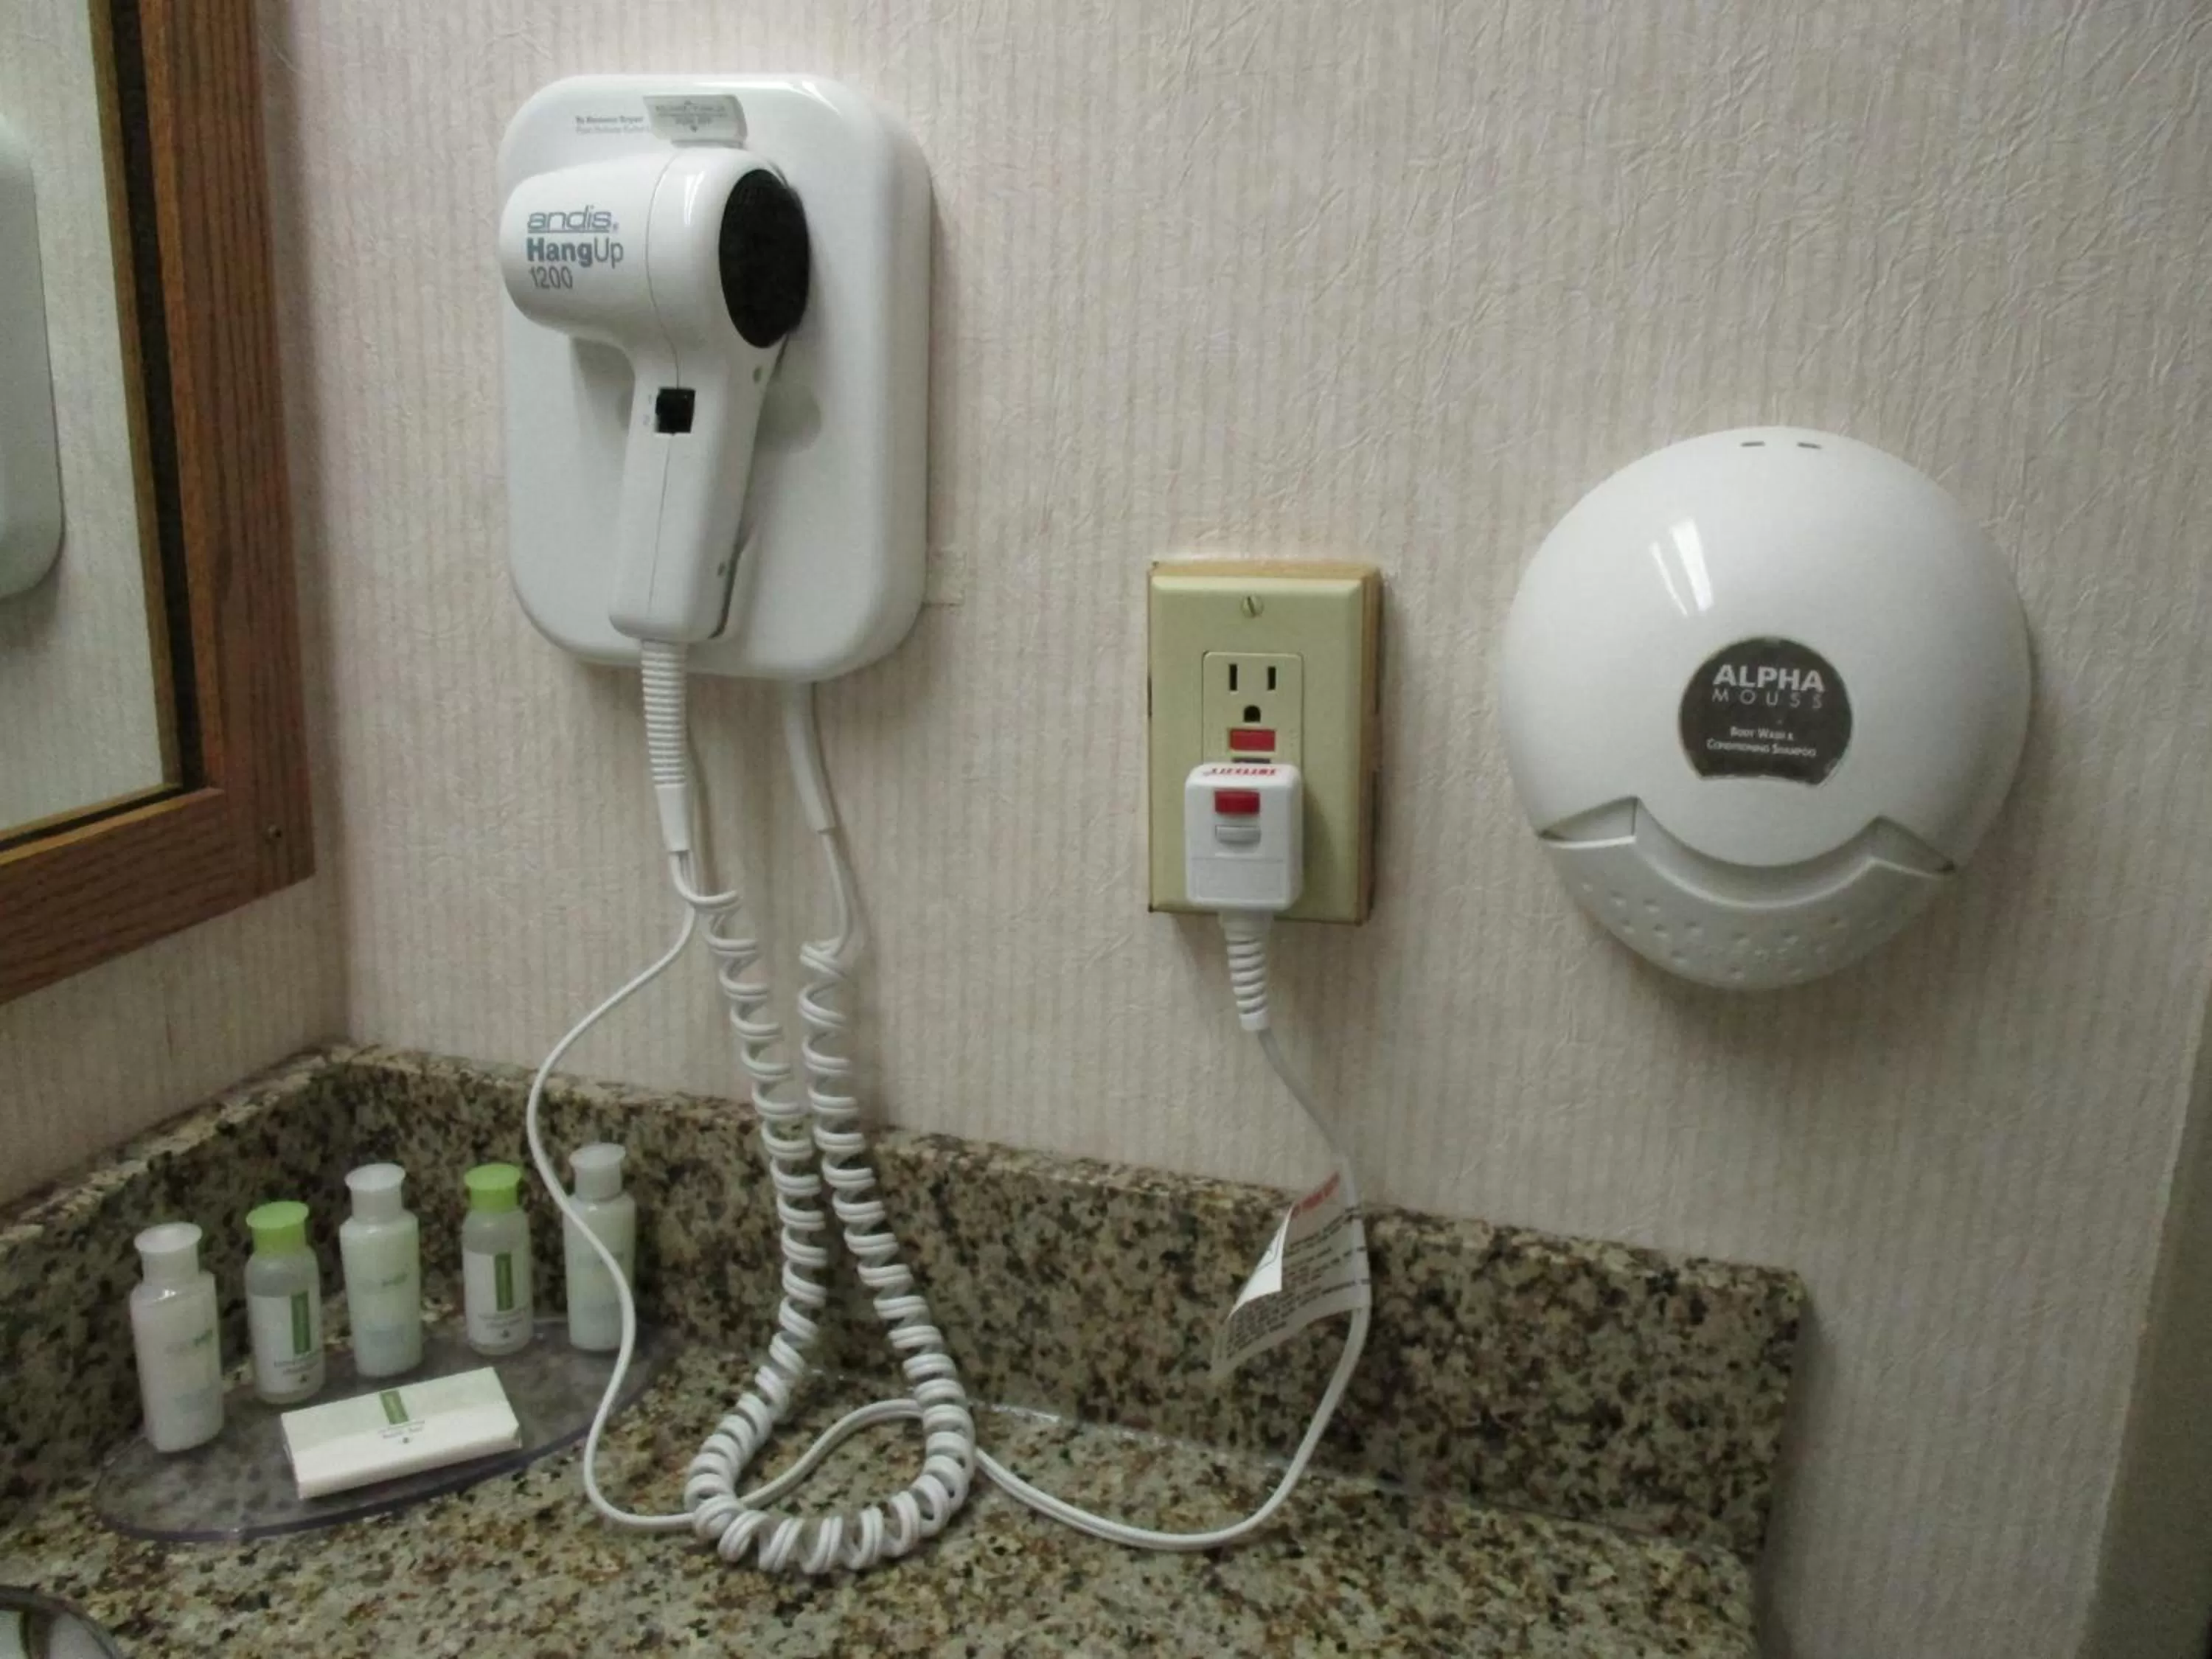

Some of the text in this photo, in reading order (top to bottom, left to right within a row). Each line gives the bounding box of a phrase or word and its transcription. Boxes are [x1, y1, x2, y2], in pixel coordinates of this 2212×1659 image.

[526, 237, 624, 269] HangUp
[528, 265, 573, 289] 1200
[1712, 664, 1826, 692] ALPHA
